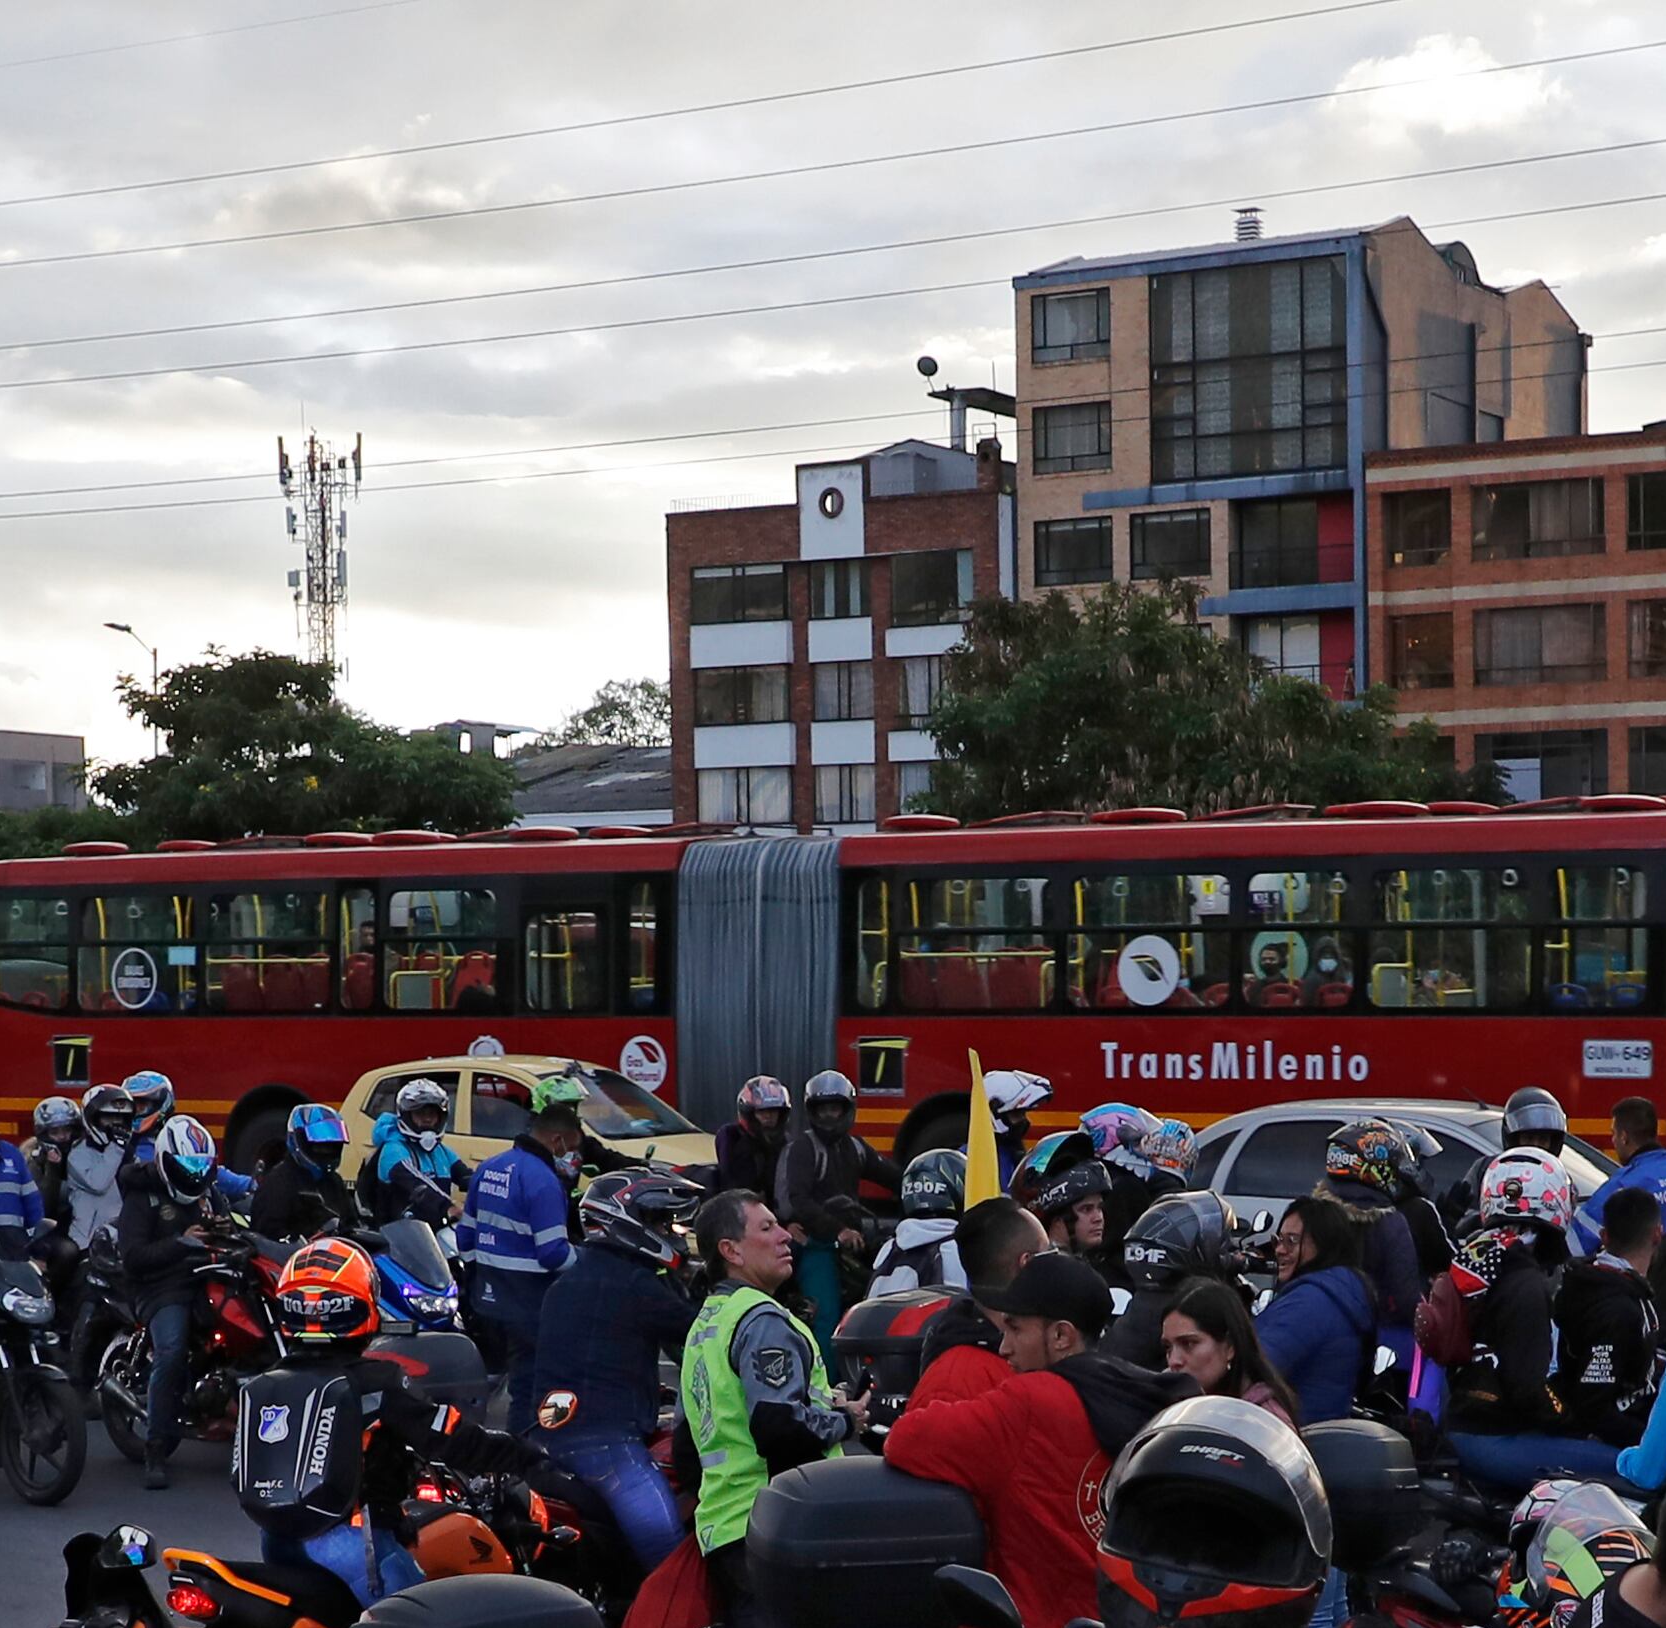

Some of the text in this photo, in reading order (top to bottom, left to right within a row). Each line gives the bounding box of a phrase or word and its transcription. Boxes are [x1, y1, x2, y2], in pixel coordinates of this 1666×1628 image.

[1100, 1040, 1369, 1082] TransMilenio
[309, 1405, 337, 1476] HONDA
[1180, 1444, 1245, 1461] SHAFT
